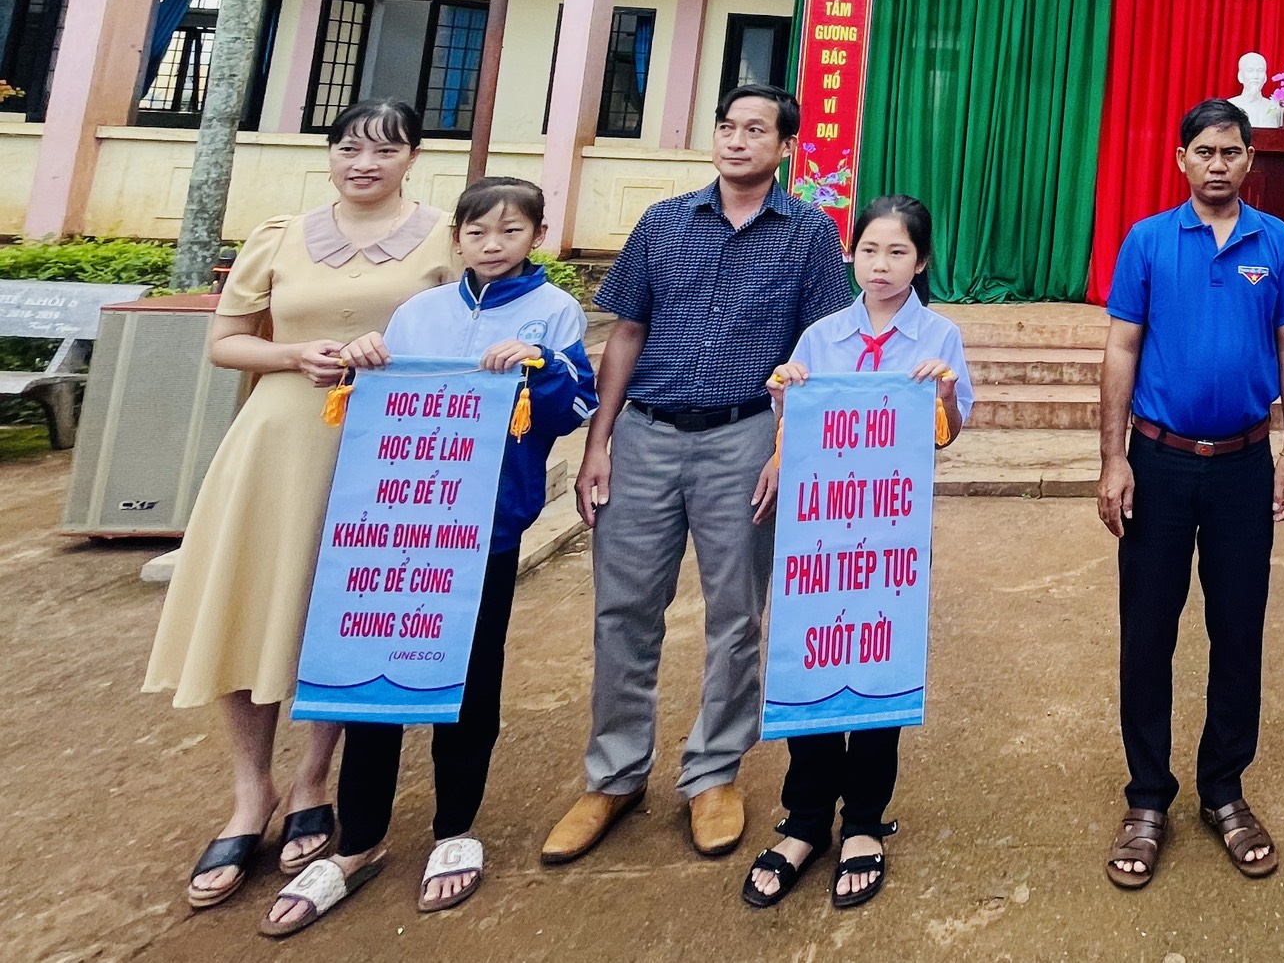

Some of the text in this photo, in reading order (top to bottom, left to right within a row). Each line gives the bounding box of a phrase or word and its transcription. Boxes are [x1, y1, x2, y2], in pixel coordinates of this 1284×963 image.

[826, 0, 851, 17] TẤM
[815, 25, 857, 41] GƯƠNG
[821, 47, 846, 65] BÁC
[824, 70, 840, 89] HỒ
[824, 97, 837, 114] VĨ
[817, 123, 838, 139] ĐẠI
[385, 385, 481, 423] HỌC ĐỂ BIẾT,
[822, 395, 895, 457] HỌC HỎI
[378, 427, 474, 465] HỌC ĐỂ LÀM
[376, 470, 462, 510] HỌC ĐỂ TỰ
[797, 470, 913, 528] LÀ MỘT VIỆC
[332, 511, 480, 554] KHẲNG ĐỊNH MÌNH,
[347, 557, 453, 598] HỌC ĐỂ CÙNG
[785, 538, 918, 596] PHẢI TIẾP TỤC
[340, 604, 443, 639] CHUNG SỐNG
[804, 609, 892, 669] SUỐT ĐỜI
[389, 651, 445, 662] (UNESCO)
